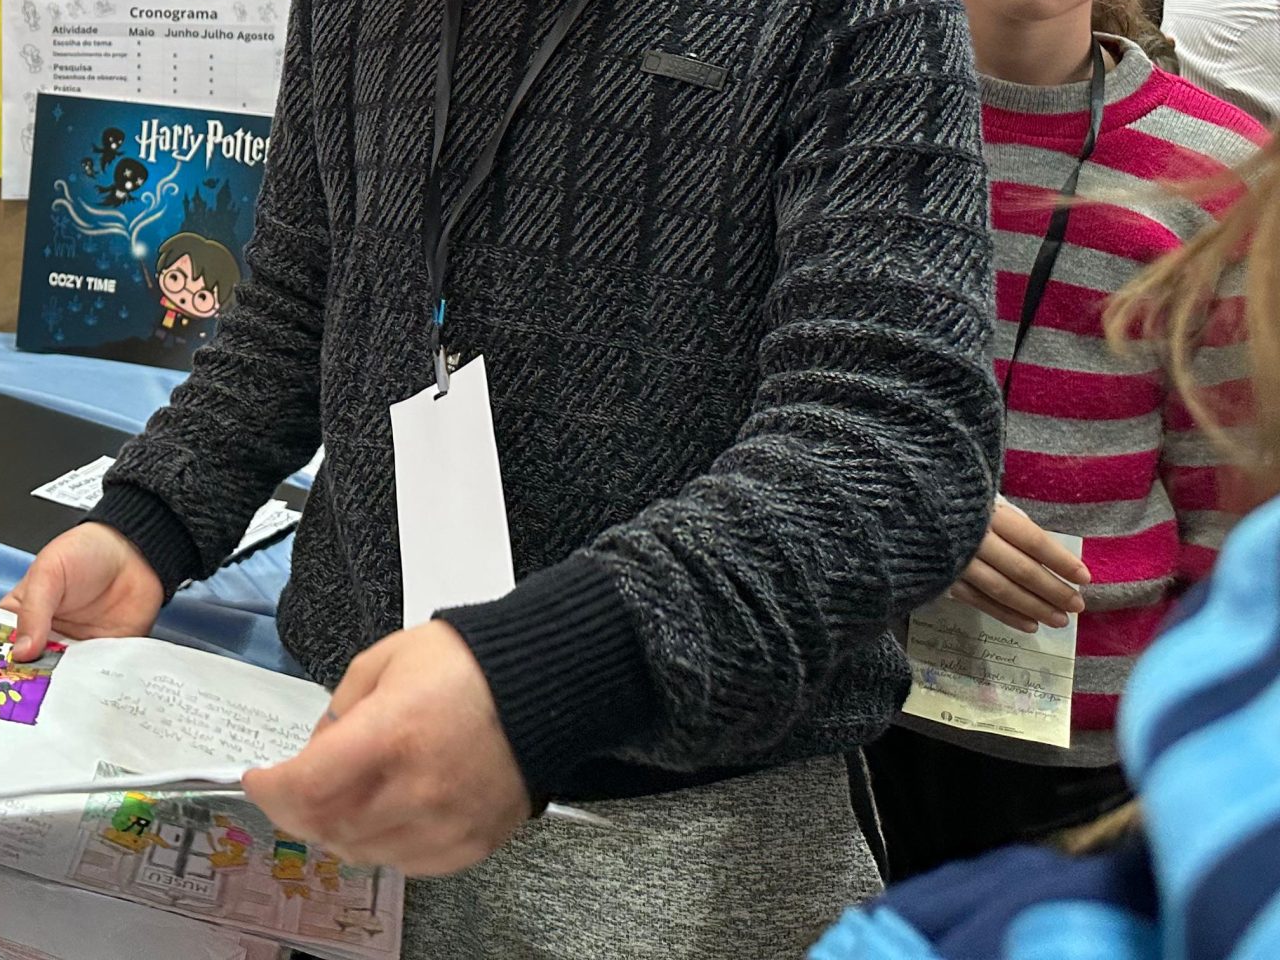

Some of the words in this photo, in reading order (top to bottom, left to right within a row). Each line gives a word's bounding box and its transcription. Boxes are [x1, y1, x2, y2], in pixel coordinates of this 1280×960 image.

[130, 7, 217, 21] Cronograma
[52, 25, 97, 34] Atividade
[128, 27, 154, 36] Maio
[164, 28, 199, 38] Junho
[201, 29, 233, 39] Julho
[236, 30, 274, 42] Agosto
[53, 63, 92, 72] Pesquisa
[135, 118, 204, 162] Harry
[48, 271, 84, 289] COZY
[85, 275, 116, 293] TIME
